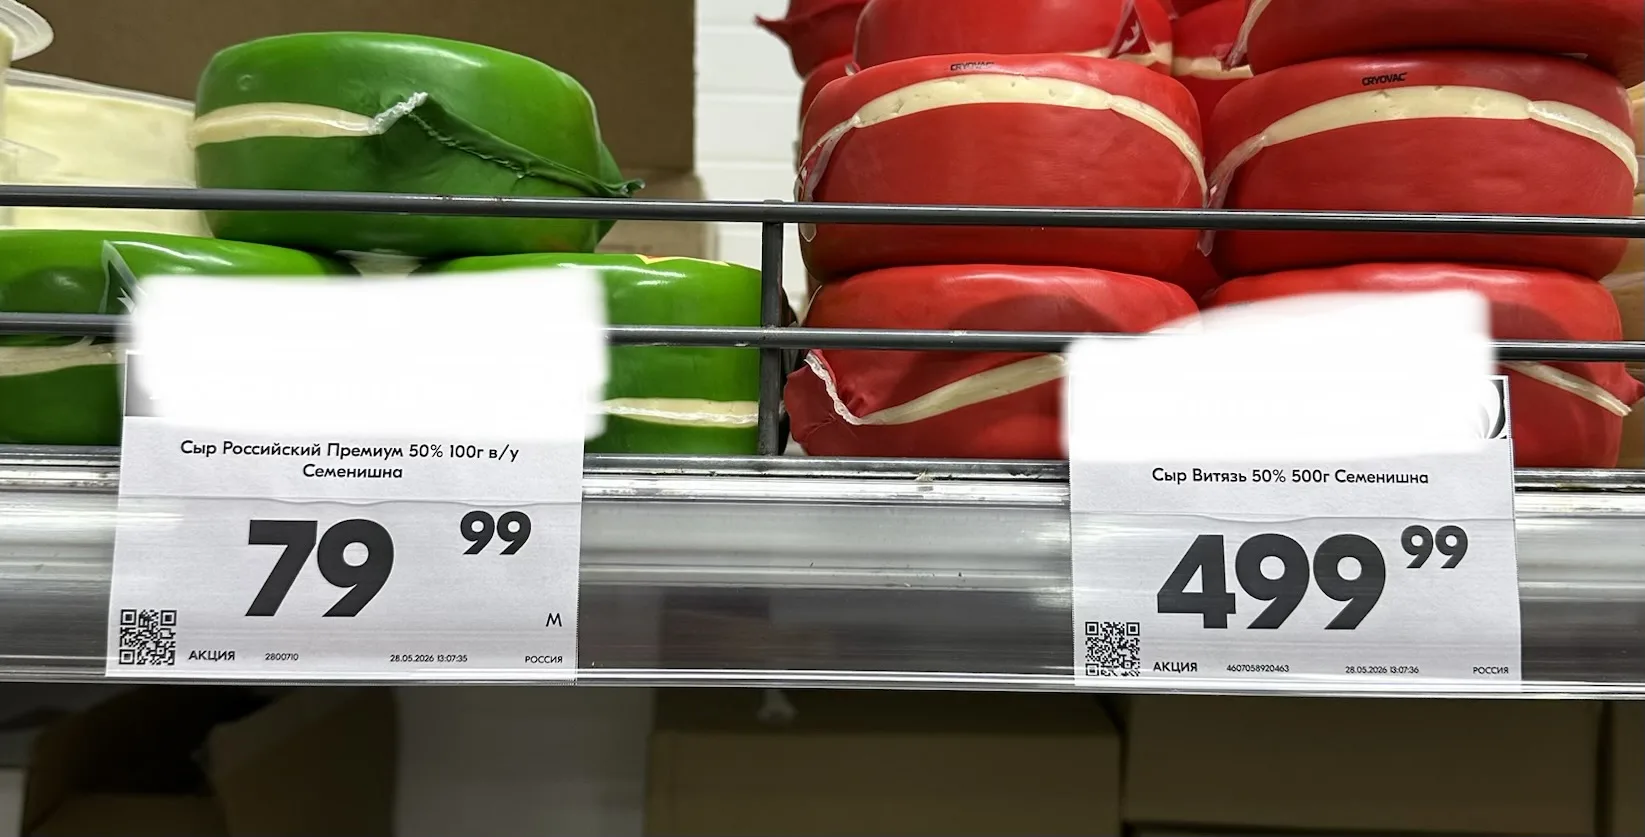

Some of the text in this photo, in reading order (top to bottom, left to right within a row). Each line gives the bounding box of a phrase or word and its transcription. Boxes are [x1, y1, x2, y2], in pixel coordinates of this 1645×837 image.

[1361, 72, 1408, 86] CRYOVAC
[180, 440, 520, 463] Сыр Российский Премиум 50% 100г в/у
[302, 463, 403, 479] Семенишна
[1152, 467, 1429, 485] Сыр Витязь 50% 500г Семенишна
[244, 510, 532, 618] 79 99
[1156, 524, 1469, 631] 499 99
[188, 650, 236, 663] АКЦИЯ
[265, 652, 299, 661] 2800710
[390, 654, 468, 663] 28.05.2026 13:07:35
[524, 655, 563, 664] РОССИЯ
[1153, 661, 1198, 675] АКЦИЯ
[1226, 664, 1290, 673] 4607058920463
[1345, 665, 1420, 674] 28.05.2026 13:07:36
[1472, 666, 1509, 675] РОССИЯ
